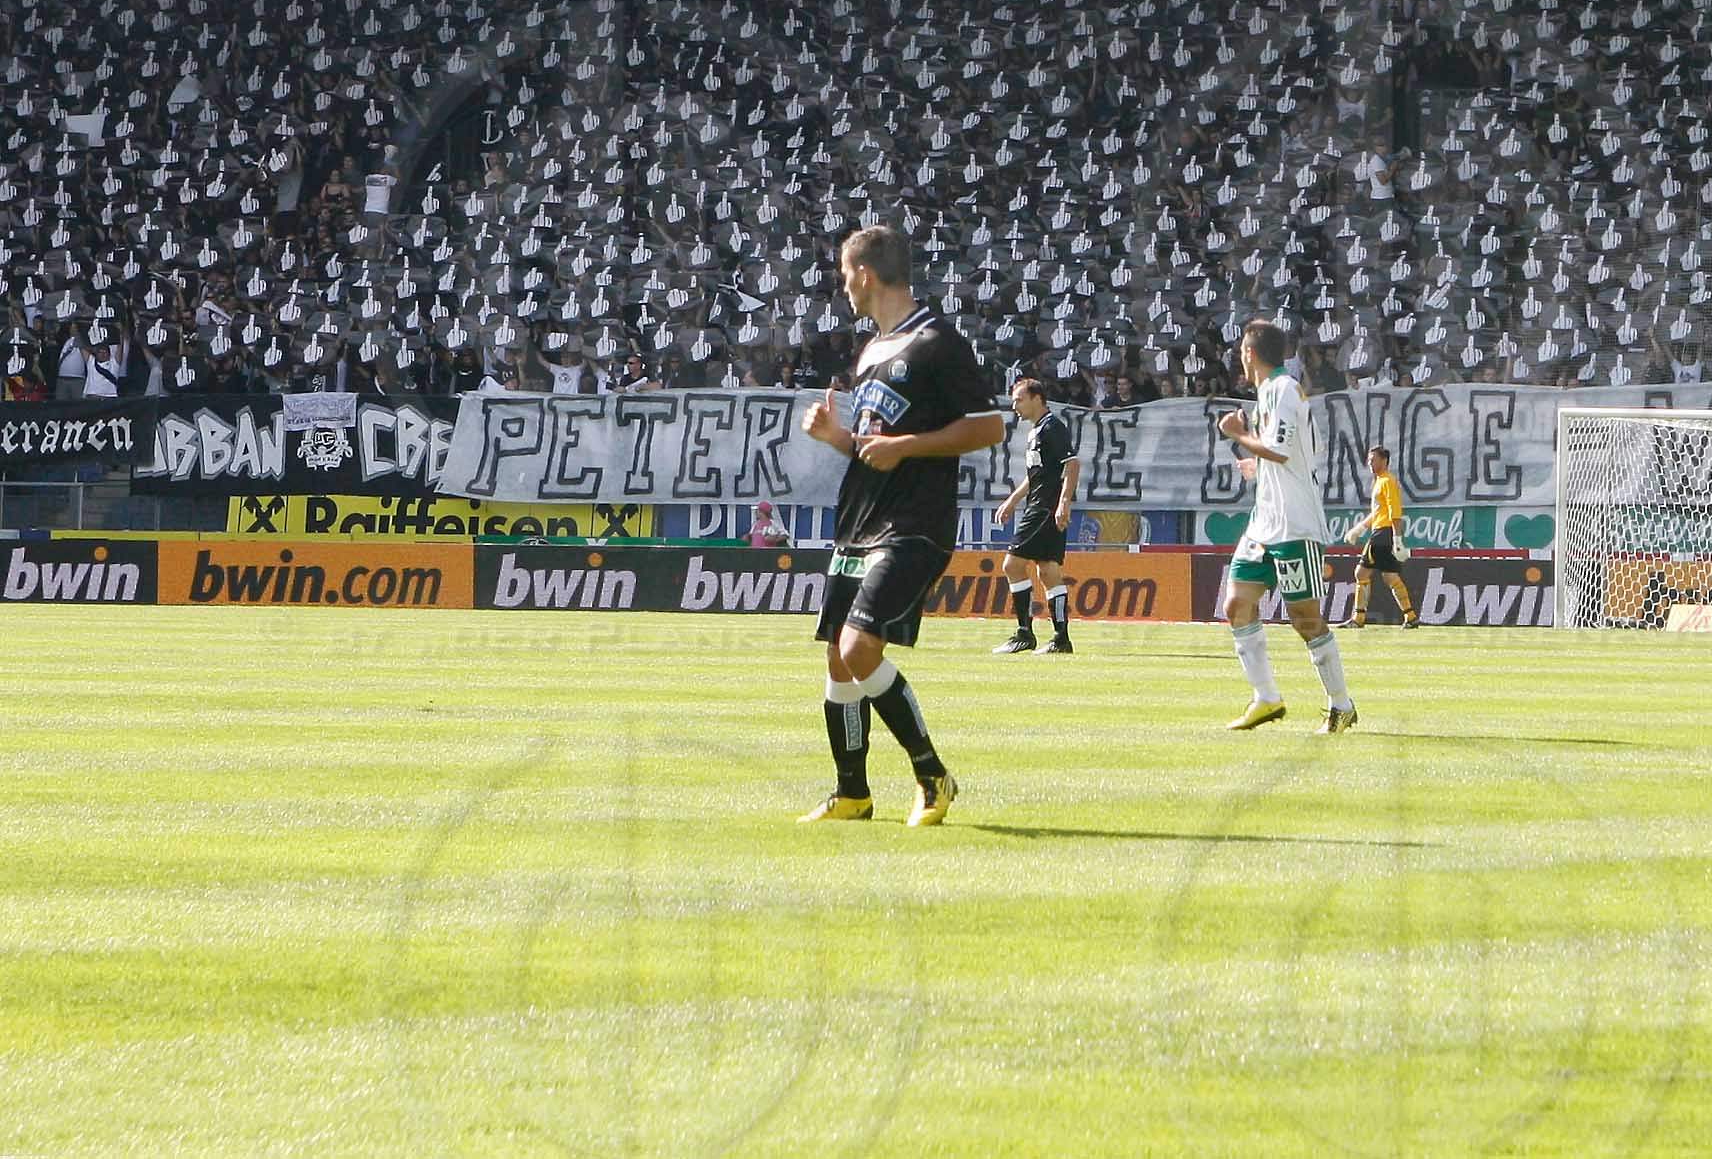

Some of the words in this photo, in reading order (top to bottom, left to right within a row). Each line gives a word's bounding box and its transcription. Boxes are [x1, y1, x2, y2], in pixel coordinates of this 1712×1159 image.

[466, 393, 796, 499] PETER
[1200, 388, 1523, 505] BNGE
[306, 495, 577, 535] Raiffeisen
[3, 547, 140, 601] bwin
[189, 549, 441, 605] bwin.com
[494, 552, 637, 609] bwin
[680, 554, 826, 611] bwin
[1420, 567, 1555, 625] bwi
